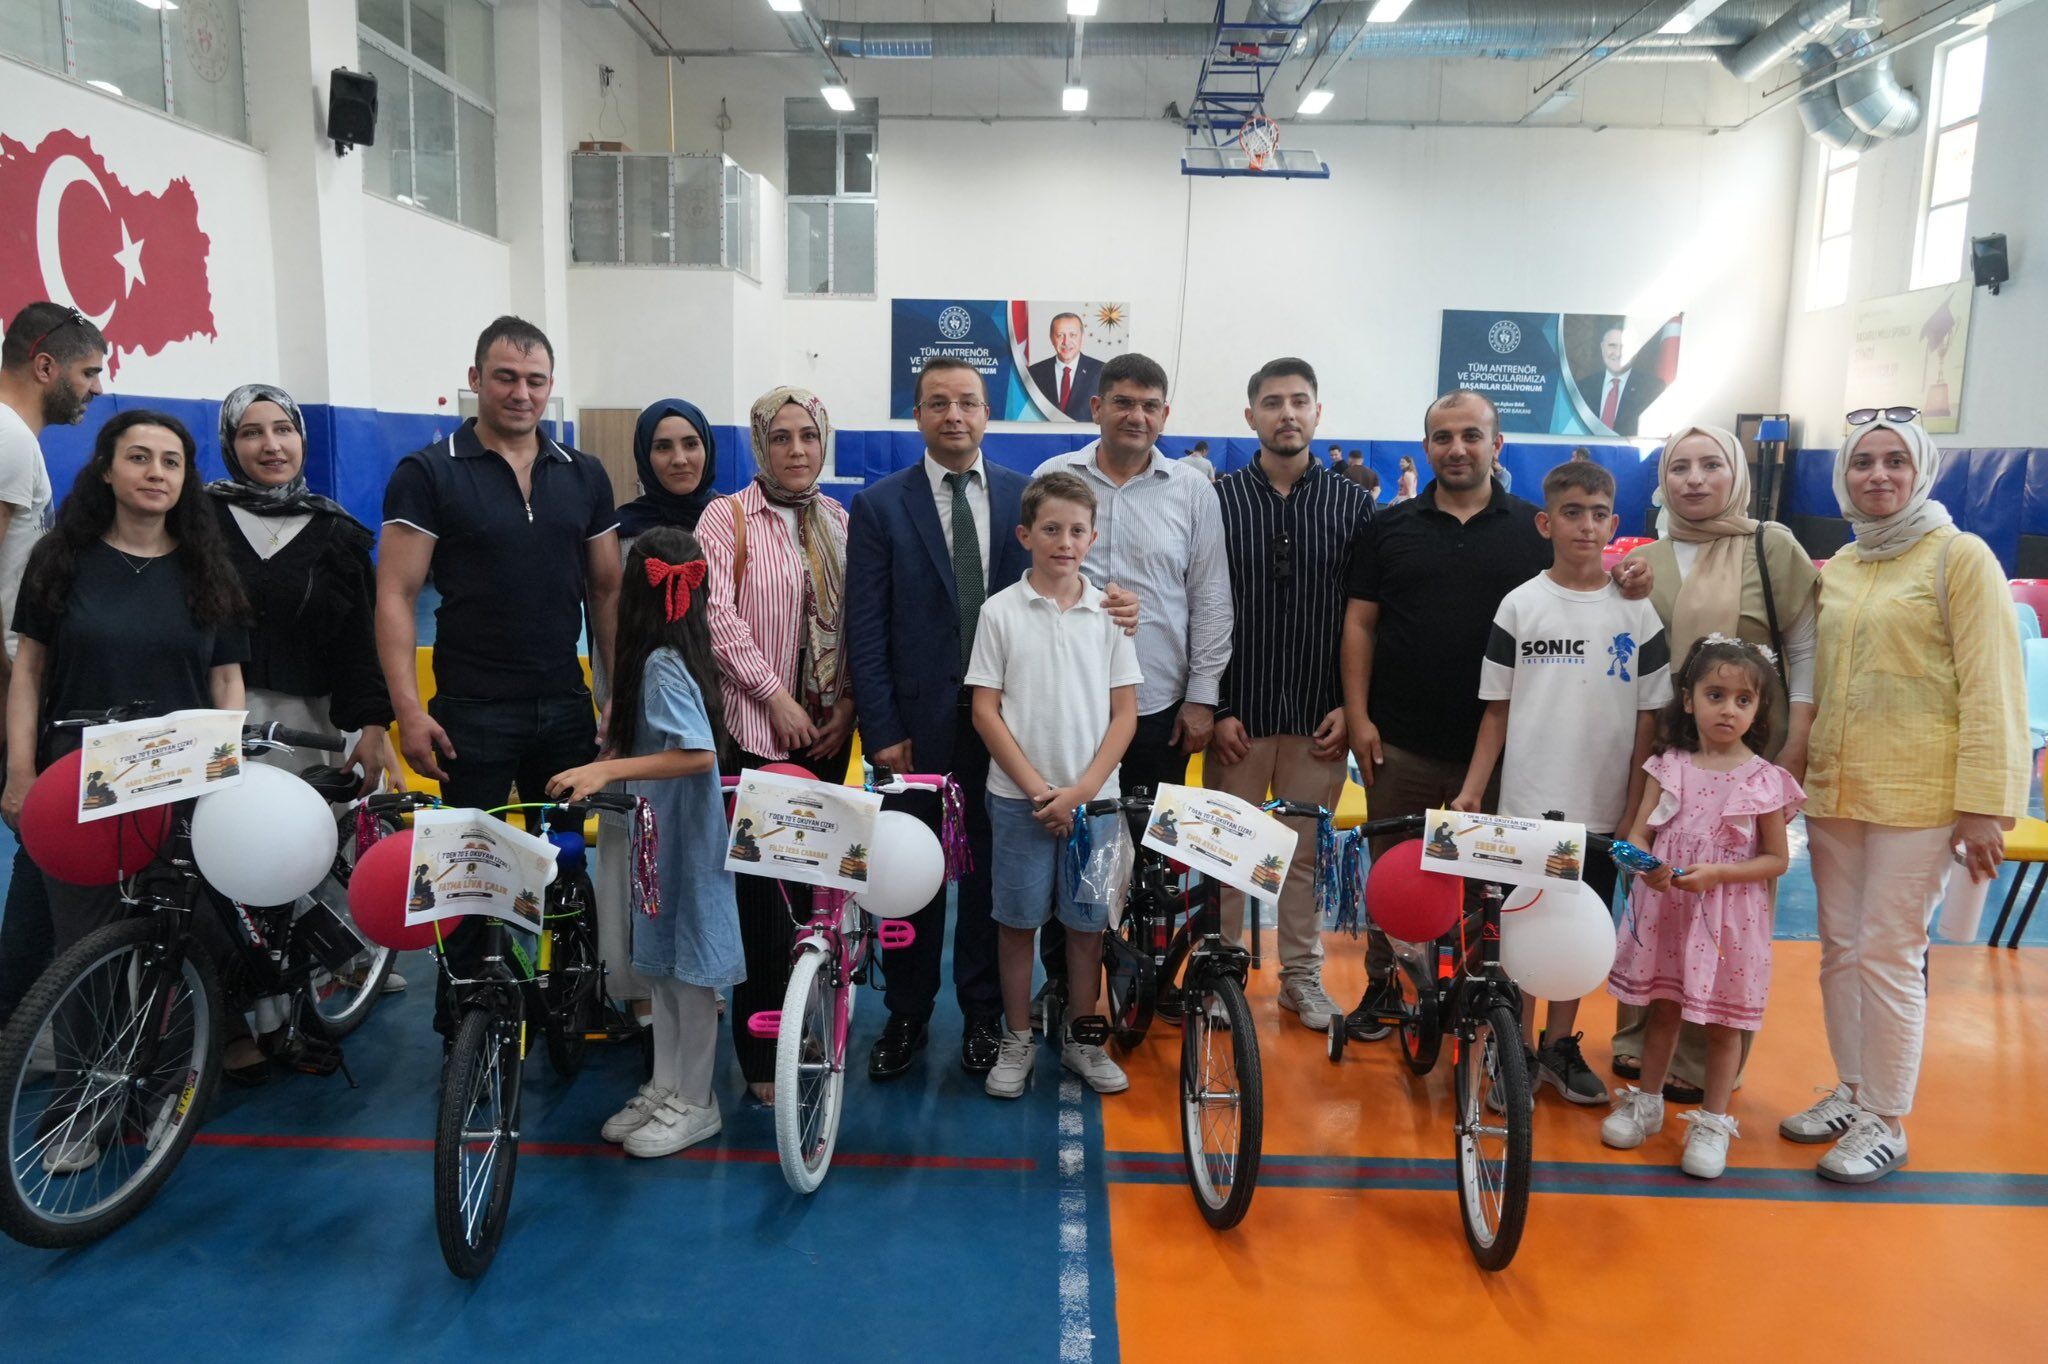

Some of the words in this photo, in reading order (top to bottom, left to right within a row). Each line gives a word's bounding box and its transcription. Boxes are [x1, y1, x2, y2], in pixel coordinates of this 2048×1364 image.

[920, 347, 939, 356] TÜM
[942, 347, 989, 357] ANTRENÖR
[910, 357, 921, 365] VE
[1468, 362, 1488, 372] TÜM
[1490, 364, 1537, 374] ANTRENÖR
[1457, 372, 1469, 380] VE
[1470, 373, 1546, 383] SPORCULARIMIZA
[1460, 382, 1500, 391] BAŞARILAR
[1502, 383, 1542, 392] DİLİYORUM
[1521, 639, 1585, 656] SONIC
